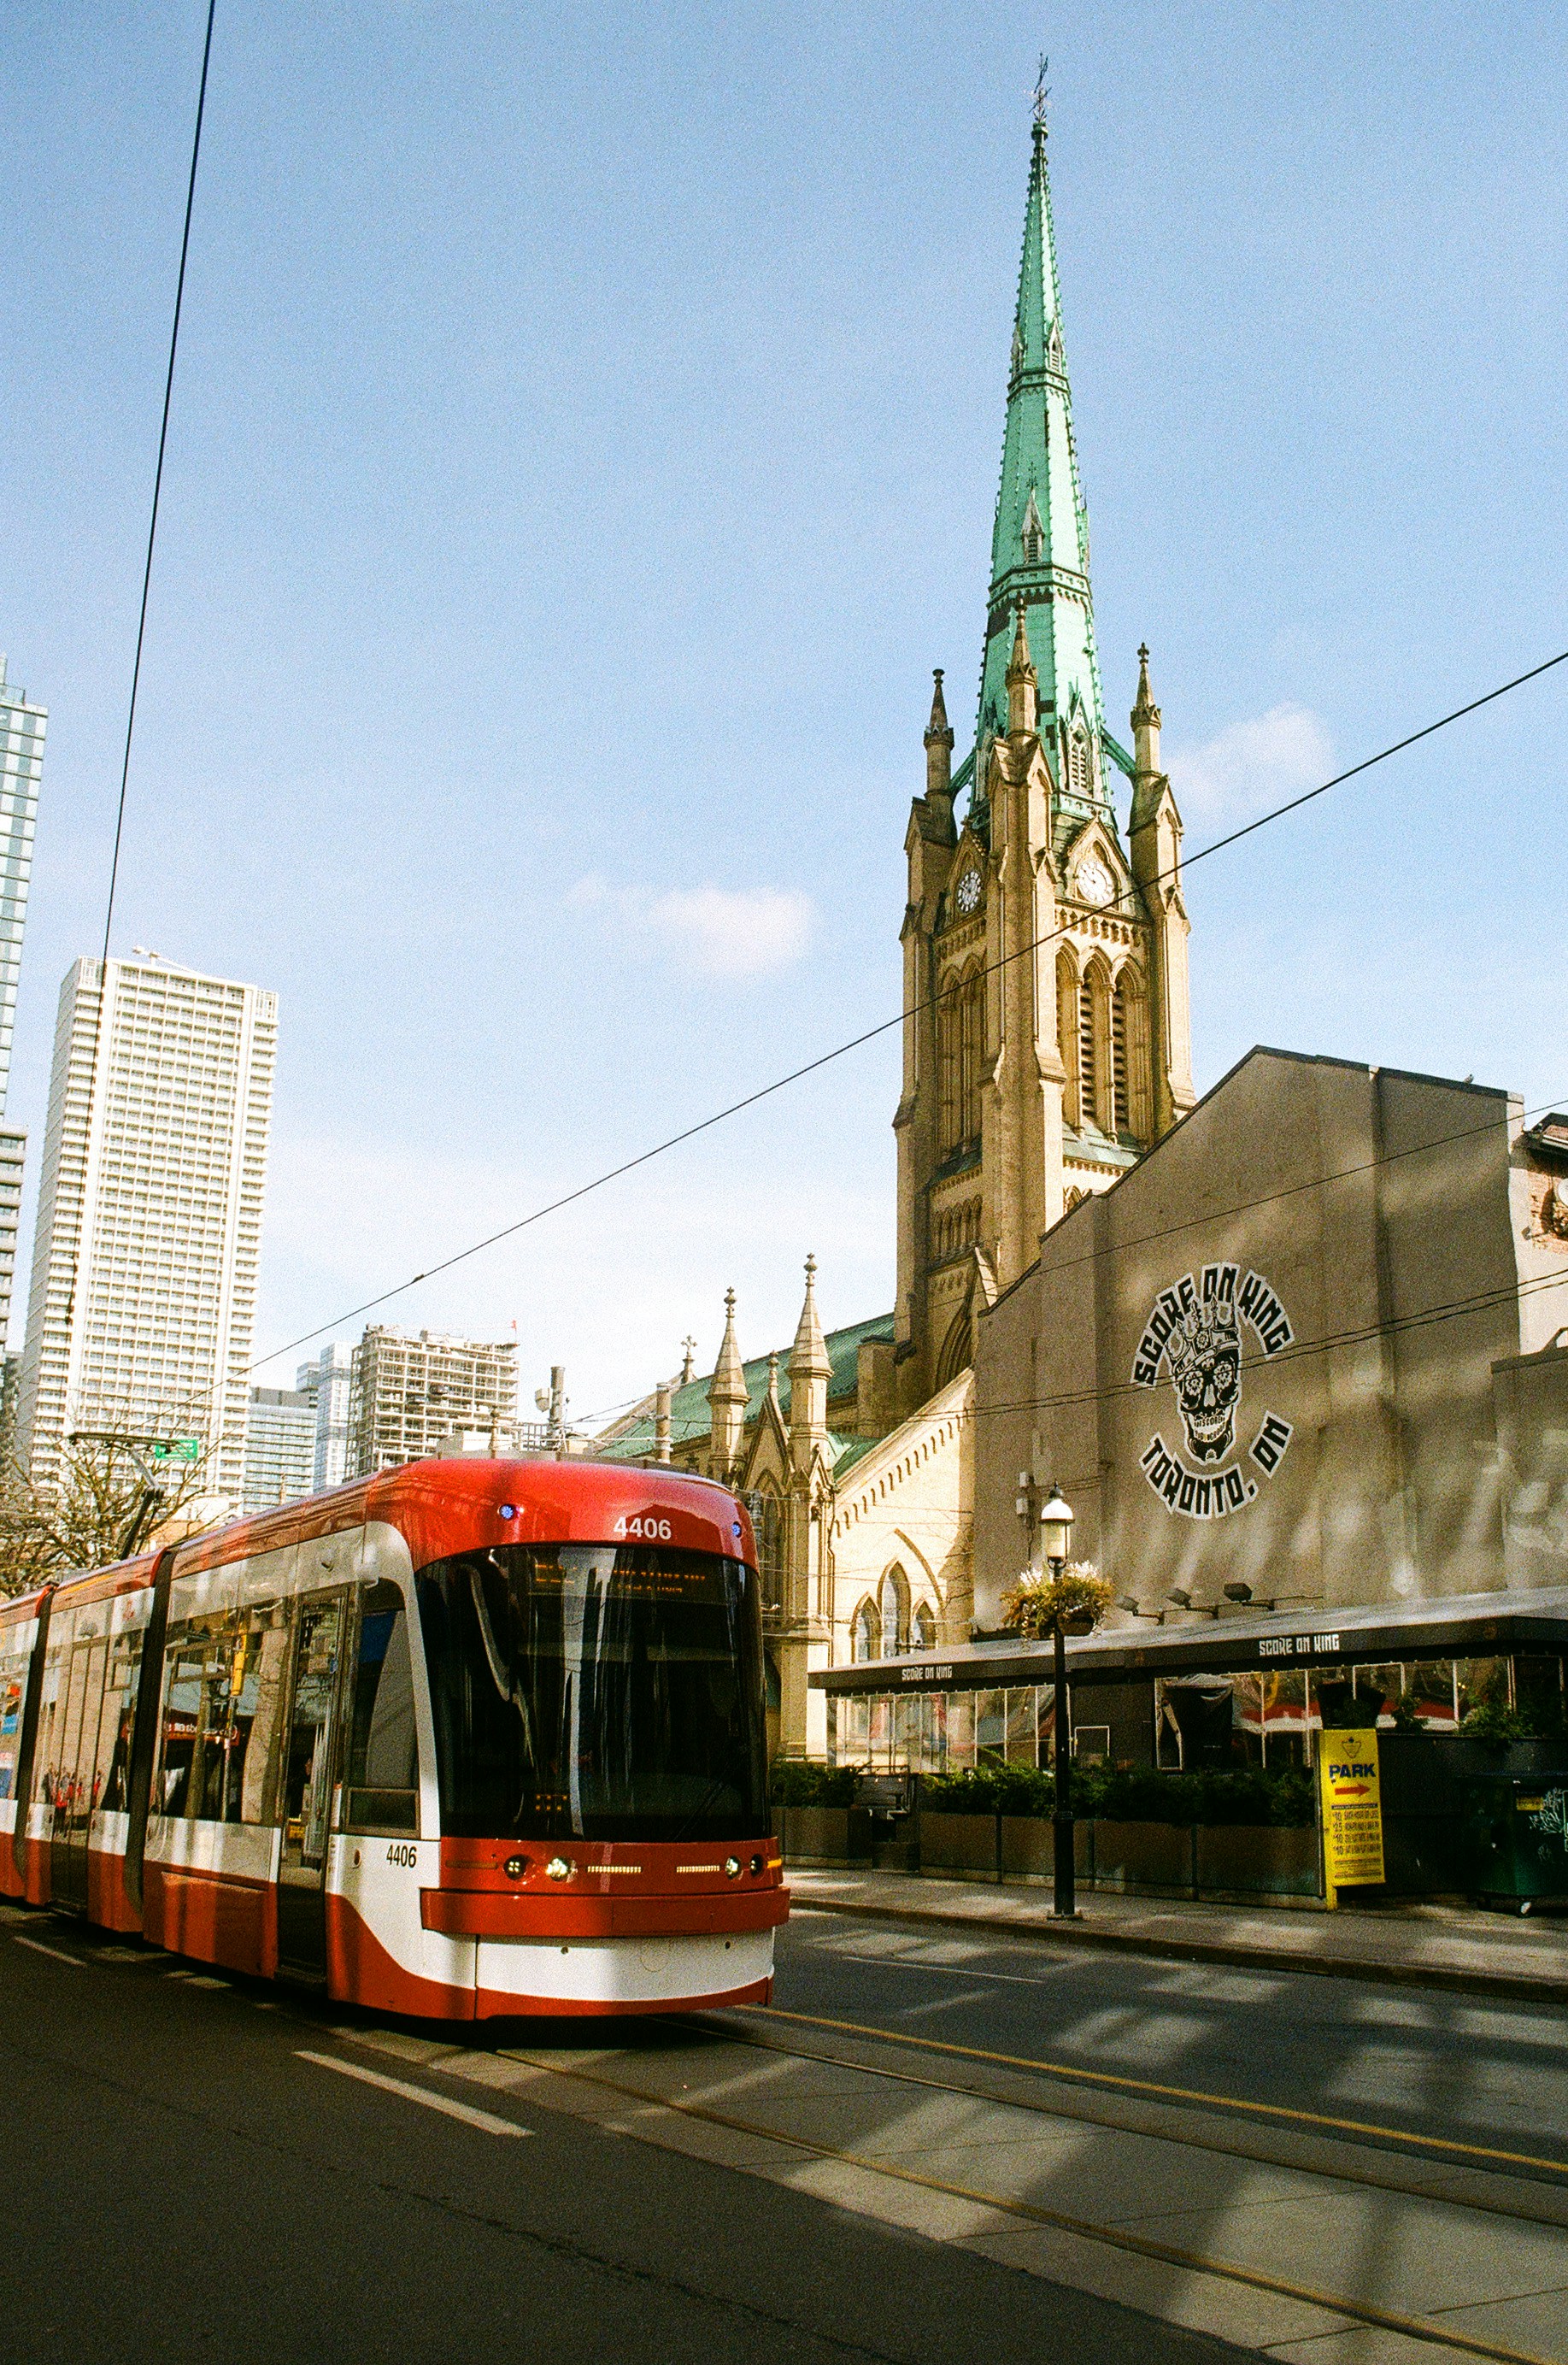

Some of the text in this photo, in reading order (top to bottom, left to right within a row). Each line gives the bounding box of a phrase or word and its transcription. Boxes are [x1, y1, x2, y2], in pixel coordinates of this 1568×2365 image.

[1133, 1266, 1291, 1386] SCORE ON KING
[1251, 1415, 1290, 1474] ON
[613, 1516, 672, 1539] 4406
[1259, 1633, 1340, 1656] SCORE ON KING
[901, 1665, 953, 1681] SCORE ON KING
[1329, 1763, 1377, 1779] PARK
[386, 1844, 417, 1868] 4406
